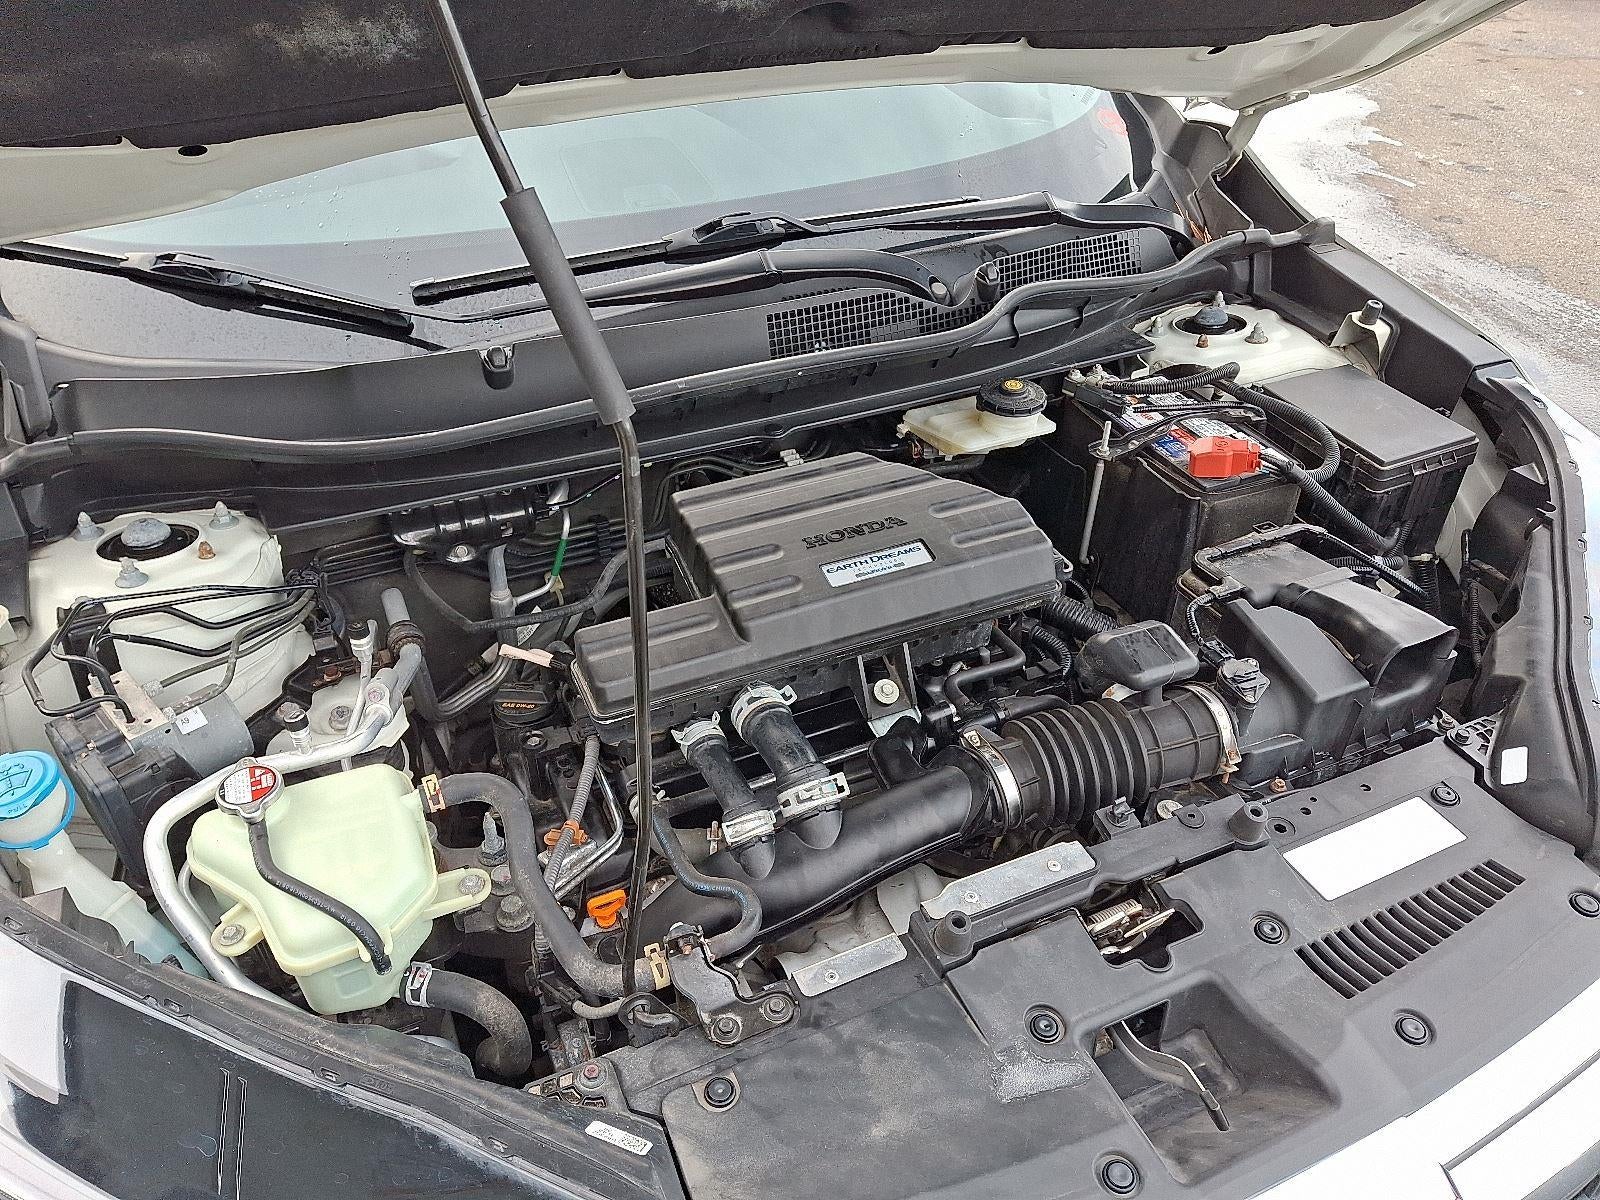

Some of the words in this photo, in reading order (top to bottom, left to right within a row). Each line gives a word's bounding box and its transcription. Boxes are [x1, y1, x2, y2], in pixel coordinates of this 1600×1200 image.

[802, 516, 908, 549] HONDA
[826, 559, 869, 574] EARTH
[869, 545, 922, 564] DREAMS
